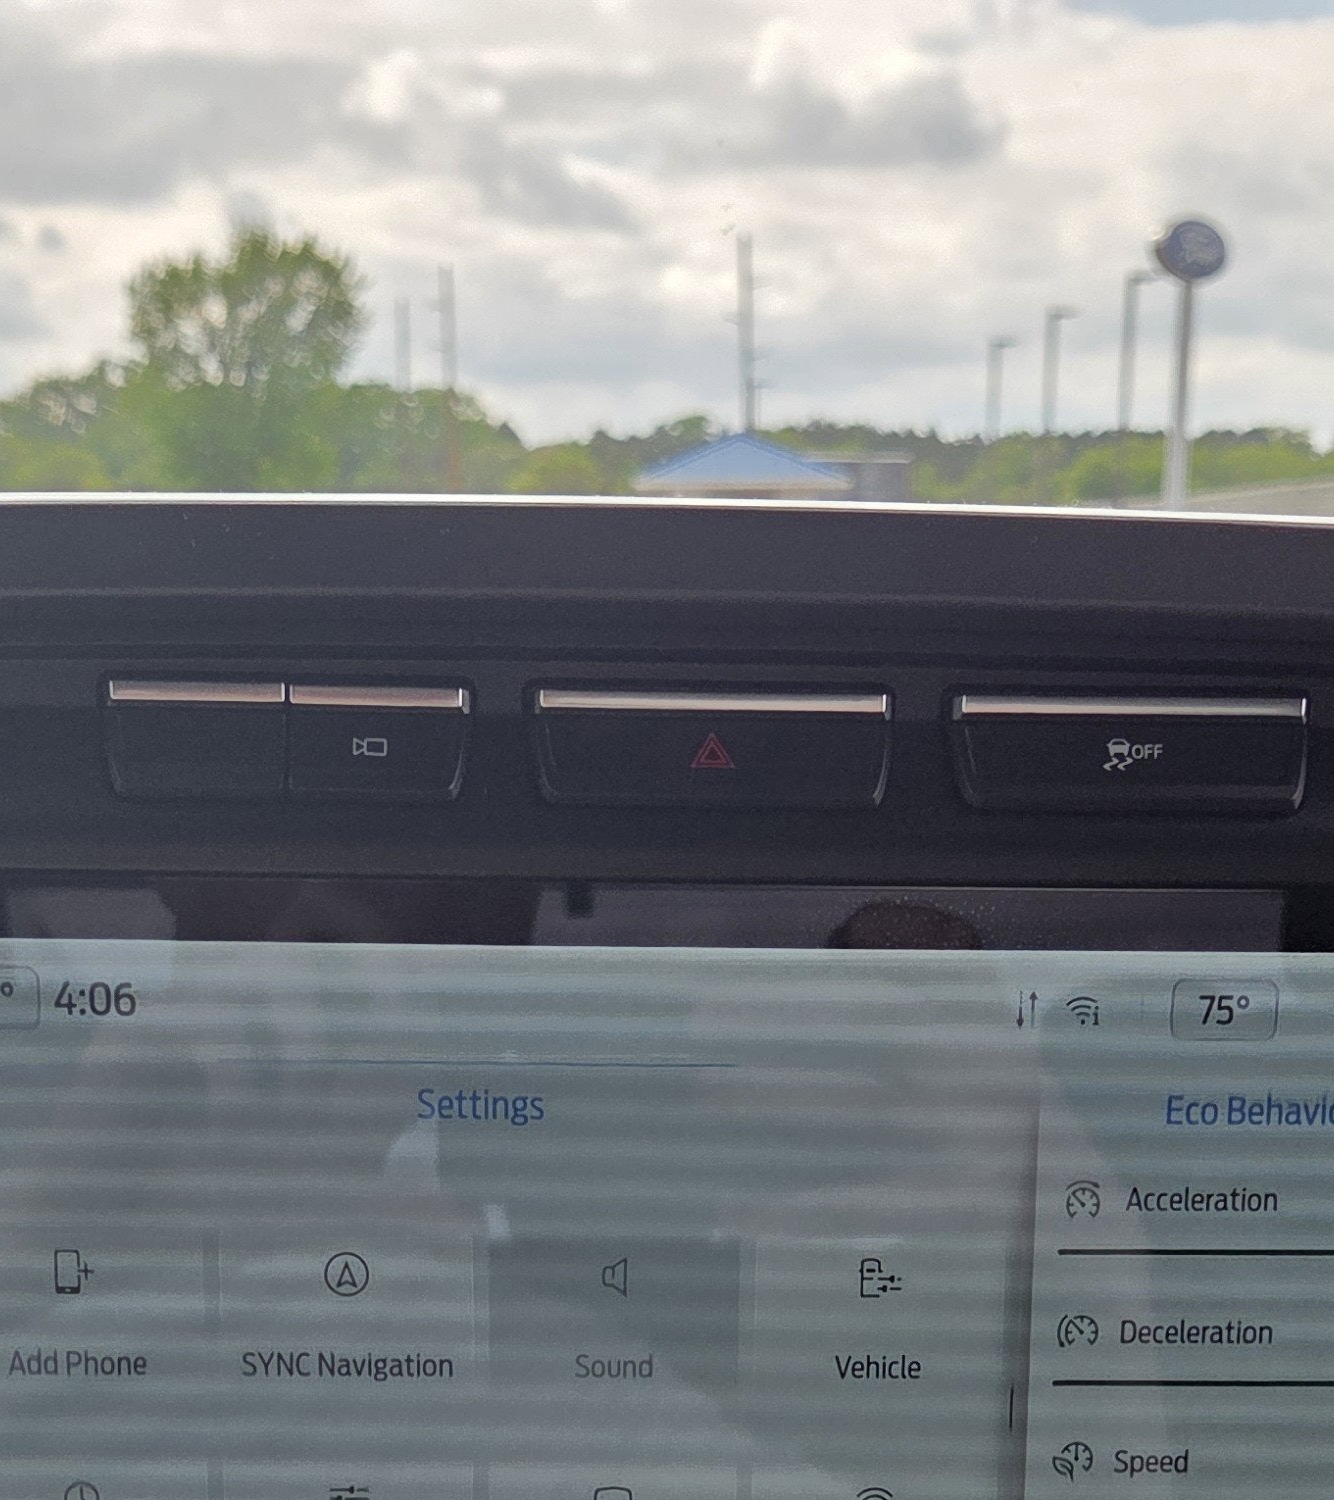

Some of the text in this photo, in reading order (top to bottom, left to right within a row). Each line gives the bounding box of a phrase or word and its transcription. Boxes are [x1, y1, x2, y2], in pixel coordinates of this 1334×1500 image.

[1131, 743, 1163, 760] OFF
[54, 981, 137, 1016] 4:06
[1199, 994, 1249, 1026] 75°
[417, 1088, 545, 1125] Settings
[1166, 1094, 1219, 1125] Eco
[1126, 1186, 1278, 1212] Acceleration
[1119, 1319, 1273, 1345] Deceleration
[8, 1349, 148, 1376] Add Phone
[242, 1351, 454, 1382] SYNC Navigation
[574, 1353, 654, 1379] Sound
[834, 1354, 922, 1380] Vehicle
[1113, 1449, 1189, 1478] Speed
